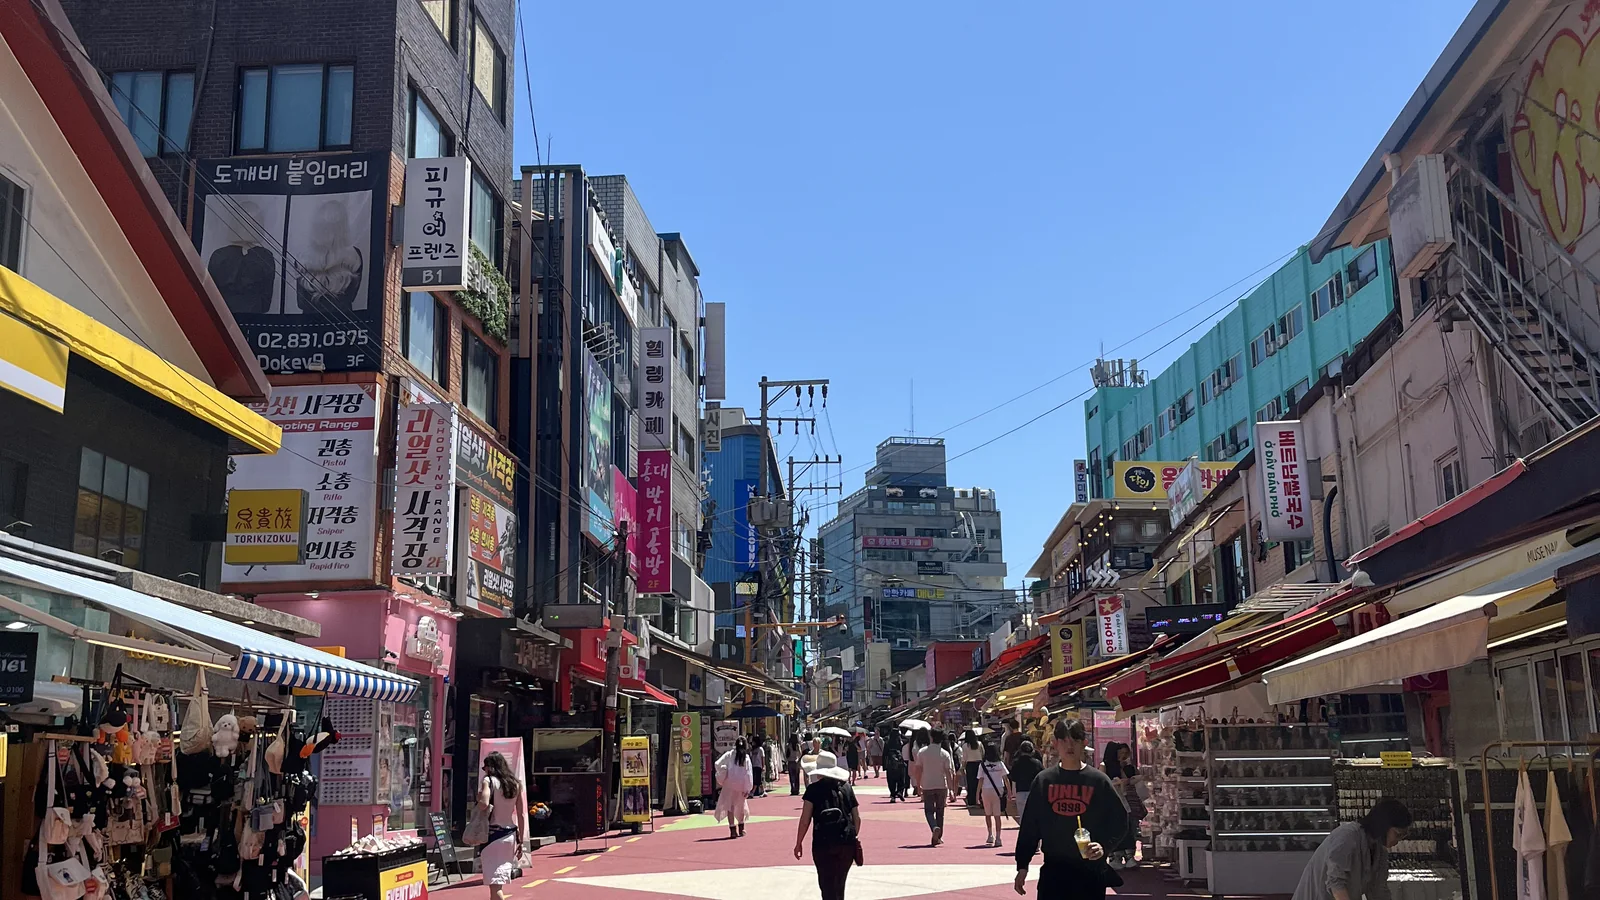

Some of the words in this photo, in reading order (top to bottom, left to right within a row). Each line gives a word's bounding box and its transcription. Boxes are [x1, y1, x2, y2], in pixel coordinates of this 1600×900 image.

[213, 164, 279, 183] 도깨비
[285, 159, 368, 186] 붙임머리
[422, 166, 448, 237] 피규어
[407, 242, 459, 260] 프렌즈
[422, 269, 443, 284] B1
[257, 329, 369, 349] 02.831.0375
[346, 354, 365, 367] 3F
[299, 393, 364, 415] 사격장
[279, 421, 314, 432] ooting
[319, 420, 359, 431] Range
[706, 411, 720, 444] 사진
[317, 438, 353, 457] 권총
[405, 408, 434, 485] 리얼샷
[434, 418, 445, 490] SHOOTING
[322, 459, 347, 467] Pistol
[486, 445, 515, 492] 사격장
[640, 458, 669, 482] 홍대
[315, 472, 352, 491] 소총
[1267, 472, 1280, 494] BÁN
[1278, 430, 1304, 530] 베트남쌀국수
[307, 505, 359, 525] 저격총
[432, 499, 443, 544] RANGE
[234, 535, 292, 543] TORIKIZOKU
[317, 528, 345, 536] Sniper
[401, 490, 432, 569] 사격장
[645, 485, 665, 576] 반지공방
[305, 540, 357, 560] 연사총
[310, 562, 334, 571] Rapid
[426, 556, 444, 568] 2F
[648, 580, 660, 589] 2F
[1103, 616, 1116, 638] PHỞ
[1048, 784, 1095, 806] UNLV
[1057, 802, 1081, 813] 1998
